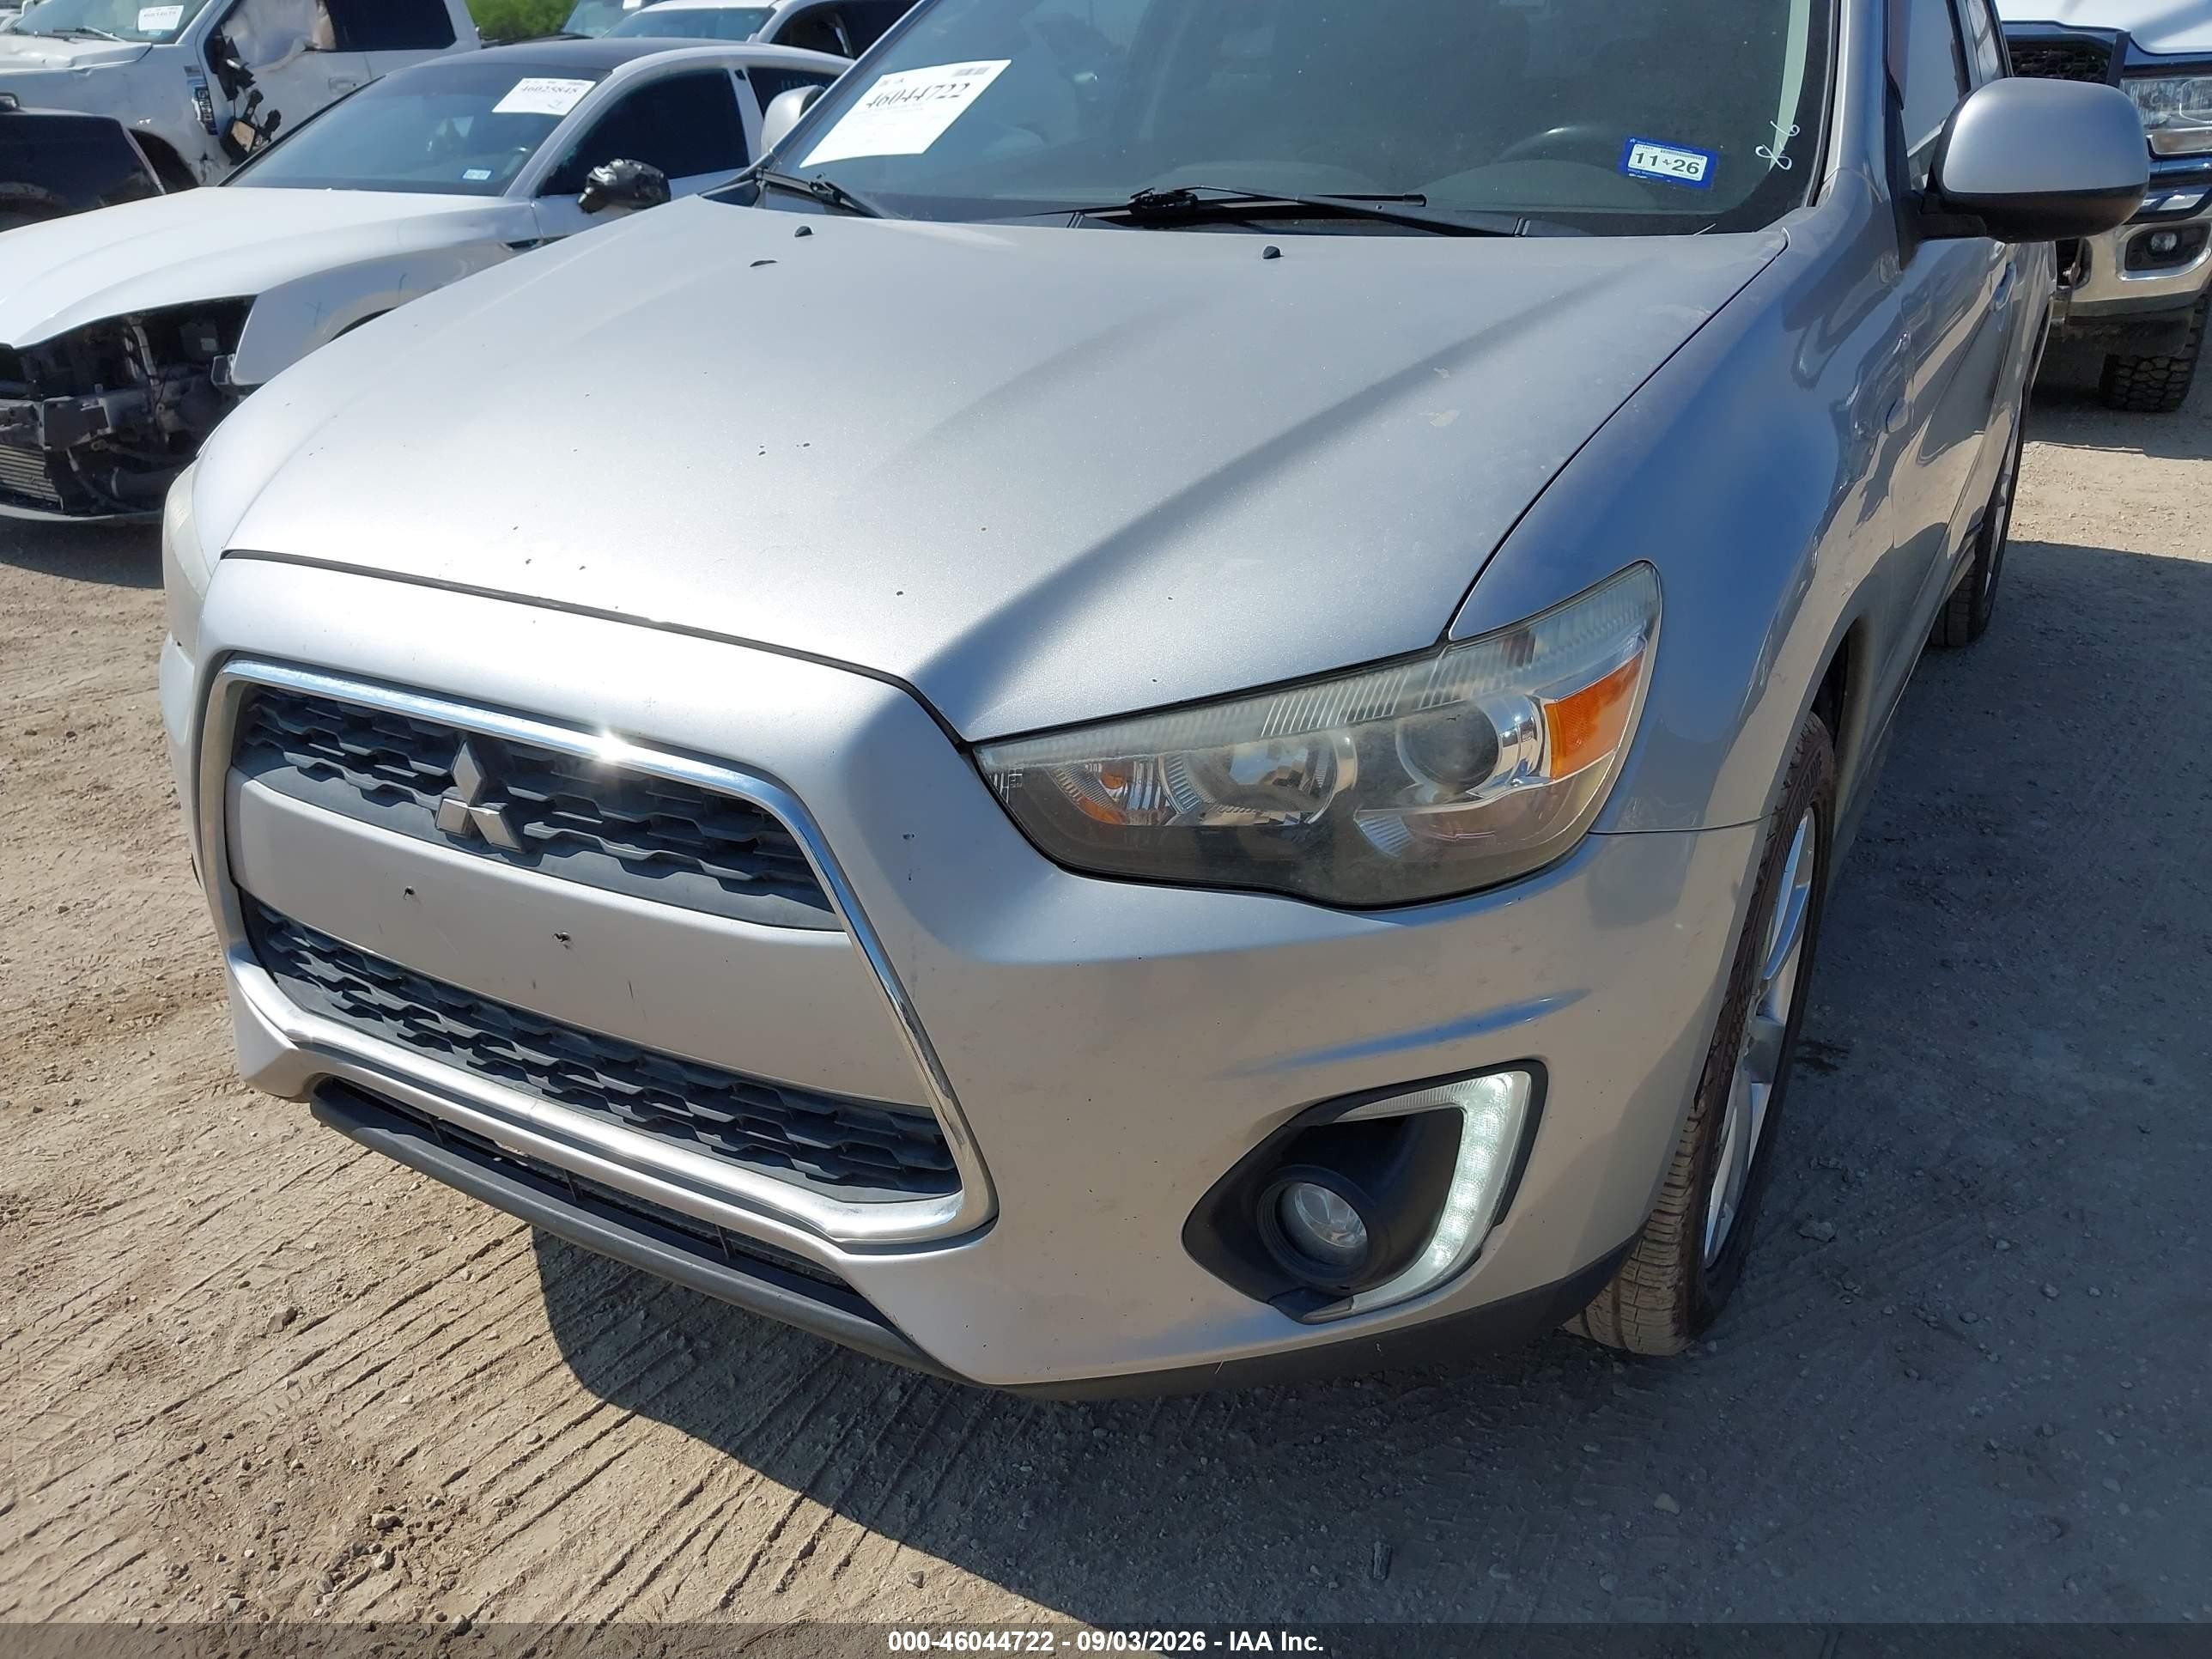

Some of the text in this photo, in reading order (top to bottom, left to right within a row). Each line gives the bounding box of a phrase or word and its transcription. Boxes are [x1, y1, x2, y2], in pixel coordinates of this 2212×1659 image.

[866, 82, 970, 107] 46044722
[1635, 153, 1658, 167] 11
[1672, 159, 1700, 174] 26
